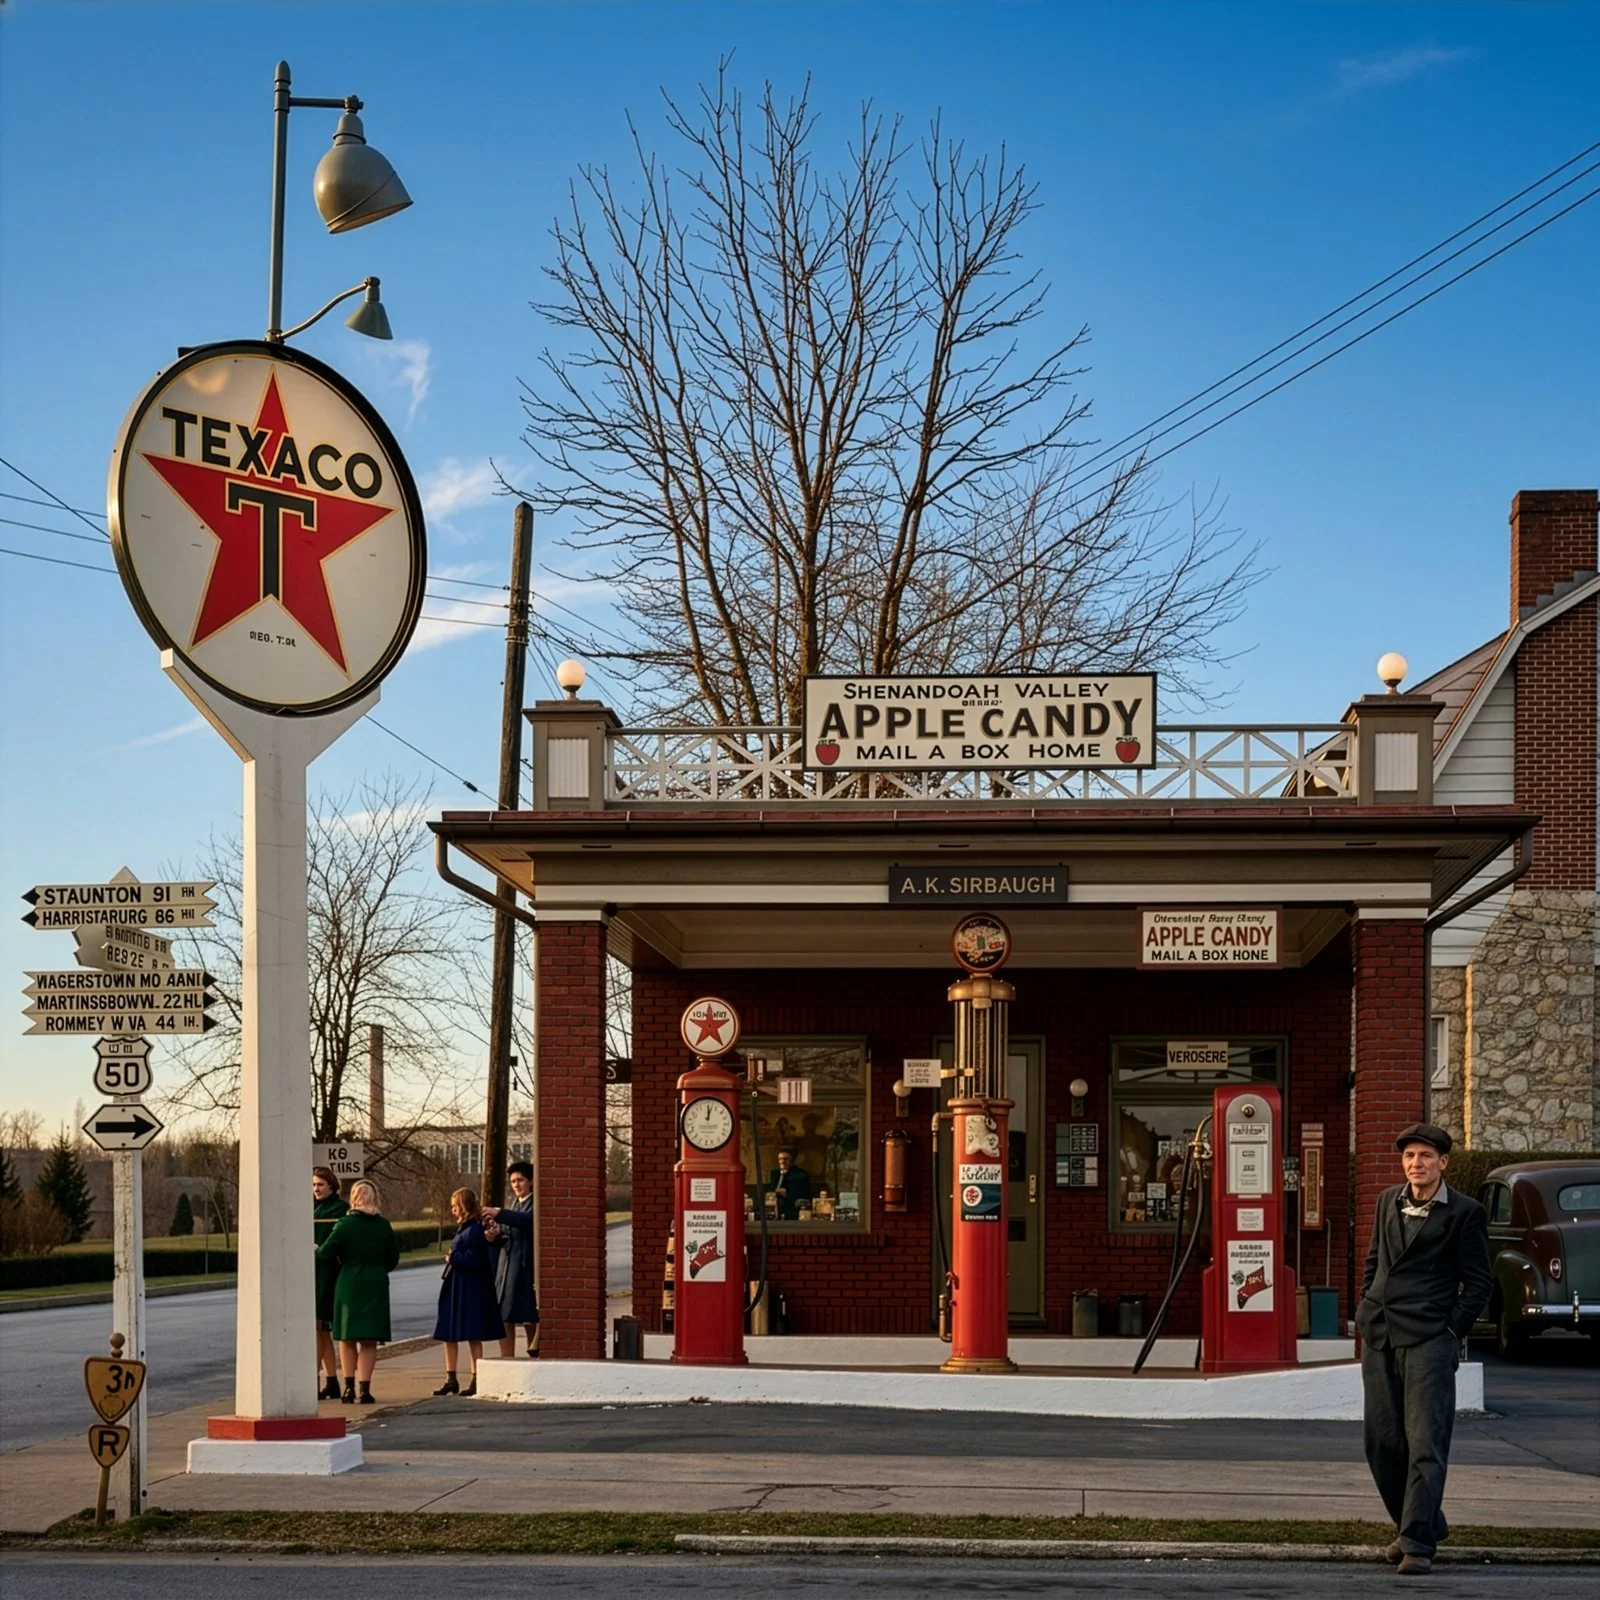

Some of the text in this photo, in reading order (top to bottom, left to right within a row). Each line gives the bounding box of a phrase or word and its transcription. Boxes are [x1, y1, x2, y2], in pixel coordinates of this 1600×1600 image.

[161, 406, 383, 499] TEXACO
[227, 480, 317, 600] T
[843, 682, 1110, 700] SHENANDOAH VALLEY
[820, 698, 1143, 740] APPLE CANDY
[856, 743, 1101, 760] MAIL A BOX HOME
[950, 876, 1056, 894] SIRBAUGH
[44, 886, 142, 904] STAUNTON
[152, 886, 171, 903] 91
[155, 908, 175, 924] 86
[1145, 925, 1274, 947] APPLE CANDY
[1151, 950, 1184, 960] MAIL
[1188, 950, 1198, 960] A
[1202, 949, 1228, 960] BOX
[163, 993, 182, 1009] 22
[45, 1015, 106, 1031] ROMMEY
[110, 1016, 124, 1031] W
[128, 1015, 147, 1031] VA
[155, 1015, 175, 1030] 44
[105, 1062, 140, 1087] 50
[97, 1430, 121, 1457] R
